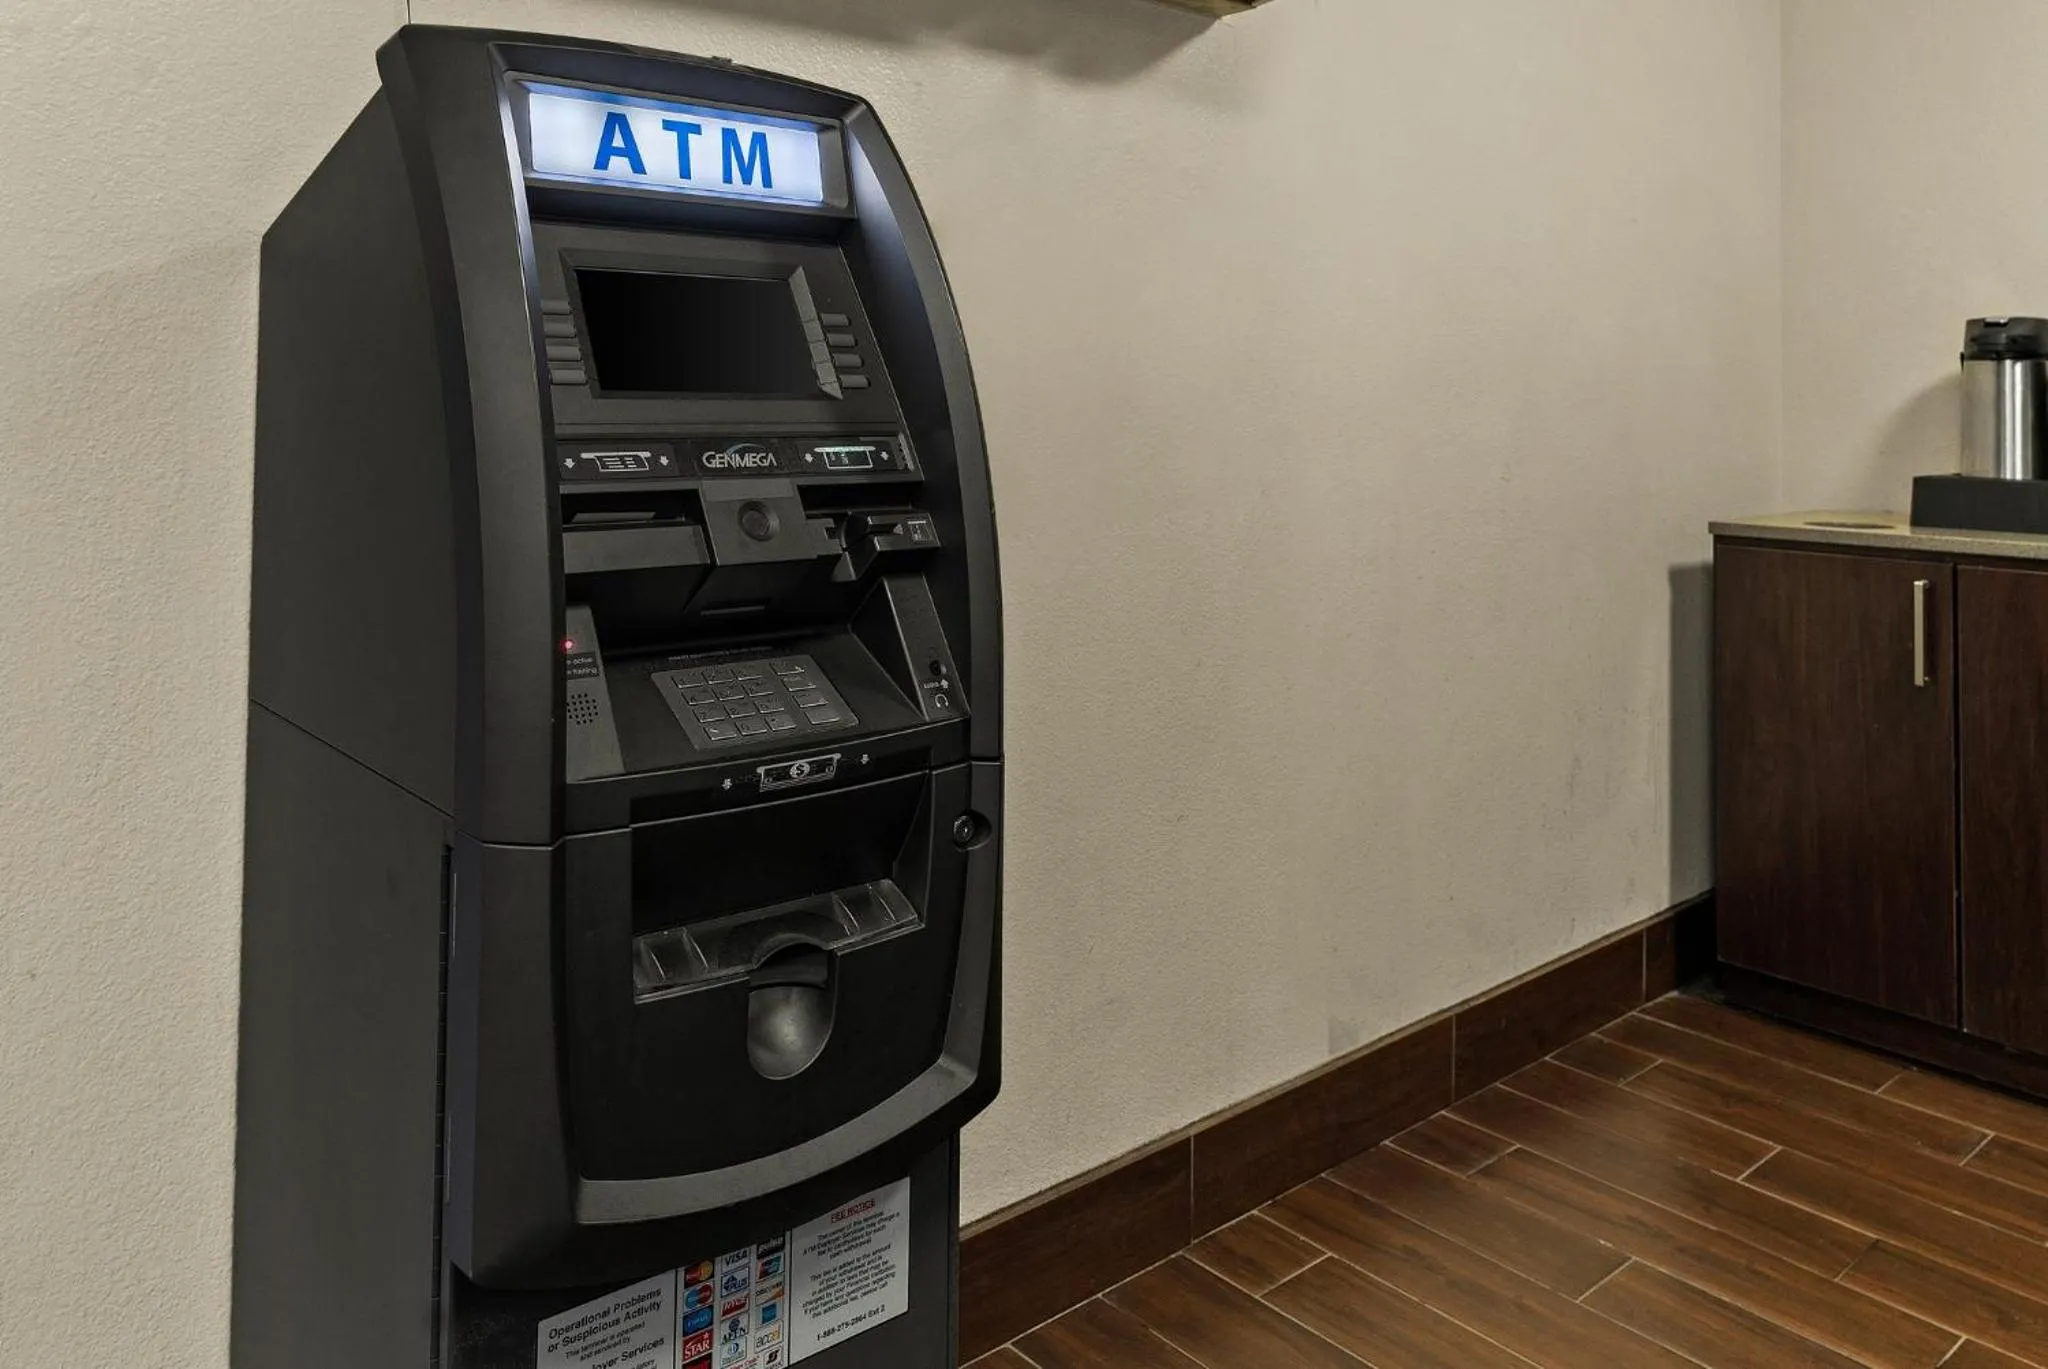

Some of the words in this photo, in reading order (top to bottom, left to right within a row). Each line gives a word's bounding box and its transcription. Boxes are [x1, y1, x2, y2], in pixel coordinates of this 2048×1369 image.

[593, 111, 773, 189] ATM
[702, 451, 777, 470] GENMEGA
[725, 1250, 748, 1267] VISA
[548, 1307, 610, 1340] Operational
[613, 1288, 661, 1313] Problems
[547, 1342, 559, 1353] or
[562, 1317, 621, 1348] Suspicious
[624, 1301, 661, 1322] Activity
[621, 1337, 664, 1362] Services
[684, 1339, 711, 1361] STAR
